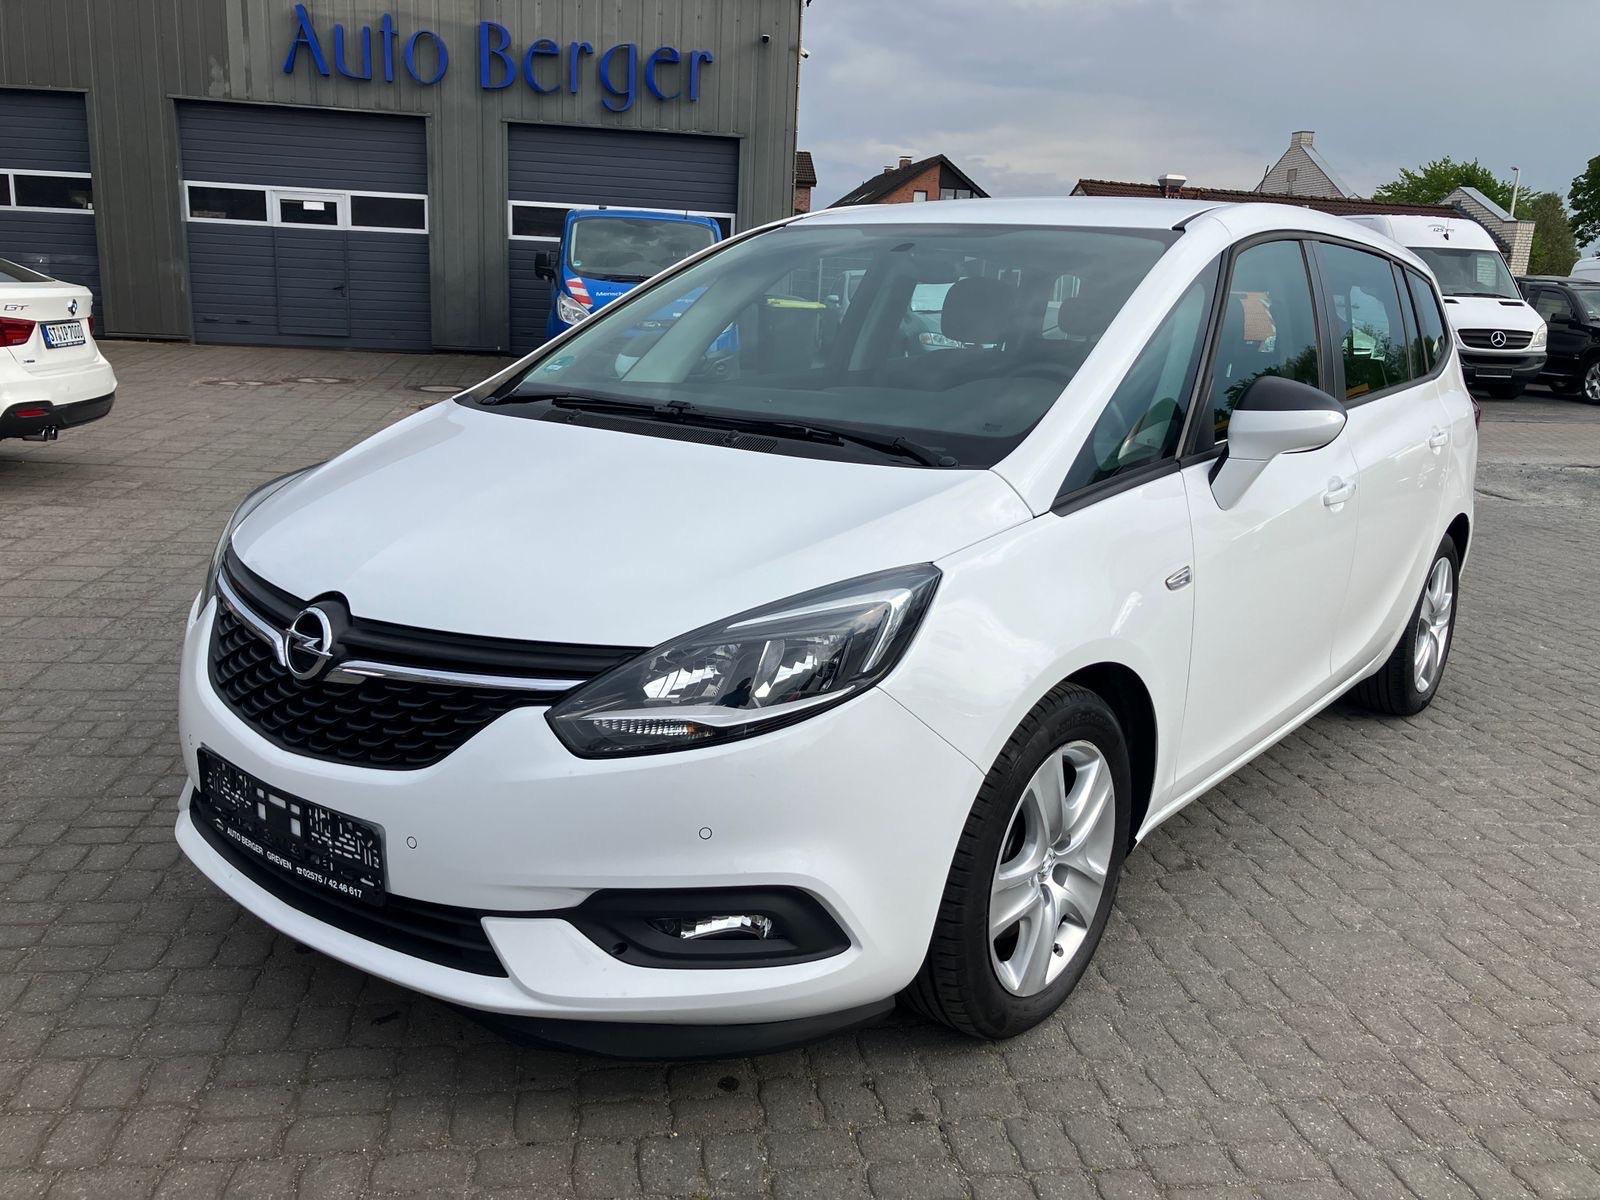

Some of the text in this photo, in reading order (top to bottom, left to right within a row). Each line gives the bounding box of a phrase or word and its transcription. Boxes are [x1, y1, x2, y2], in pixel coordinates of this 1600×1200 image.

[283, 3, 714, 113] Auto Berger
[227, 827, 241, 841] AUTO
[241, 836, 263, 855] BERGER
[267, 851, 292, 870] GREVEN
[302, 868, 323, 883] 02575
[328, 879, 338, 890] 42
[338, 883, 348, 893] 46
[349, 887, 362, 898] 617
